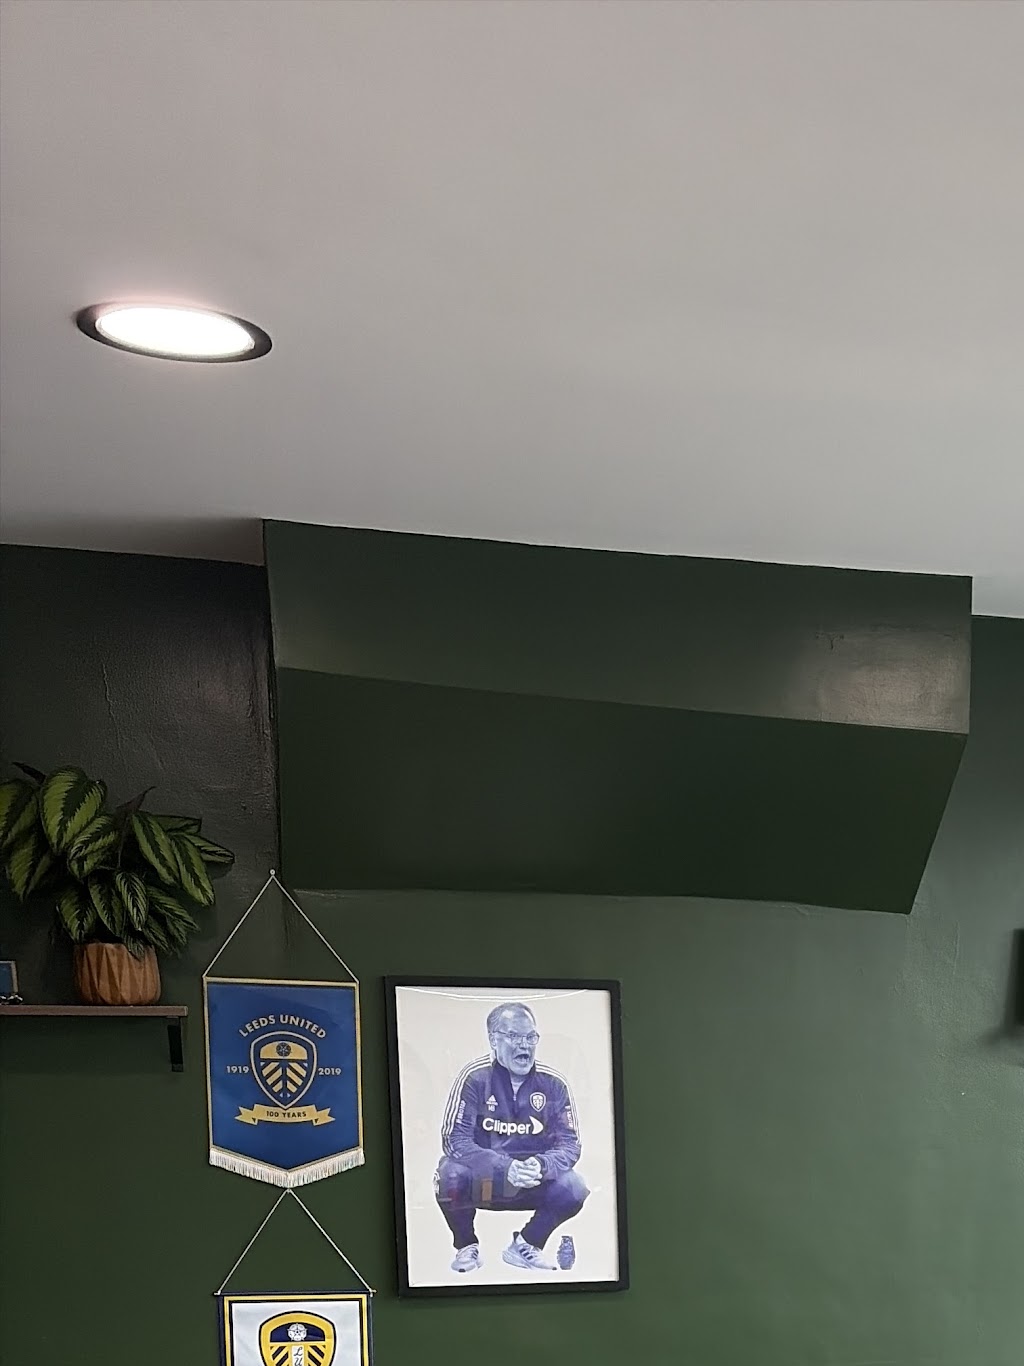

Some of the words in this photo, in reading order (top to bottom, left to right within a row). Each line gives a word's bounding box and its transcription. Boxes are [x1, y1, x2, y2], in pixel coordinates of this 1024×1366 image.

[239, 1015, 276, 1037] LEEDS
[279, 1015, 327, 1039] UNITED
[226, 1065, 249, 1074] 1919
[318, 1067, 341, 1076] 2019
[266, 1110, 279, 1118] 100
[482, 1117, 531, 1136] Clipper
